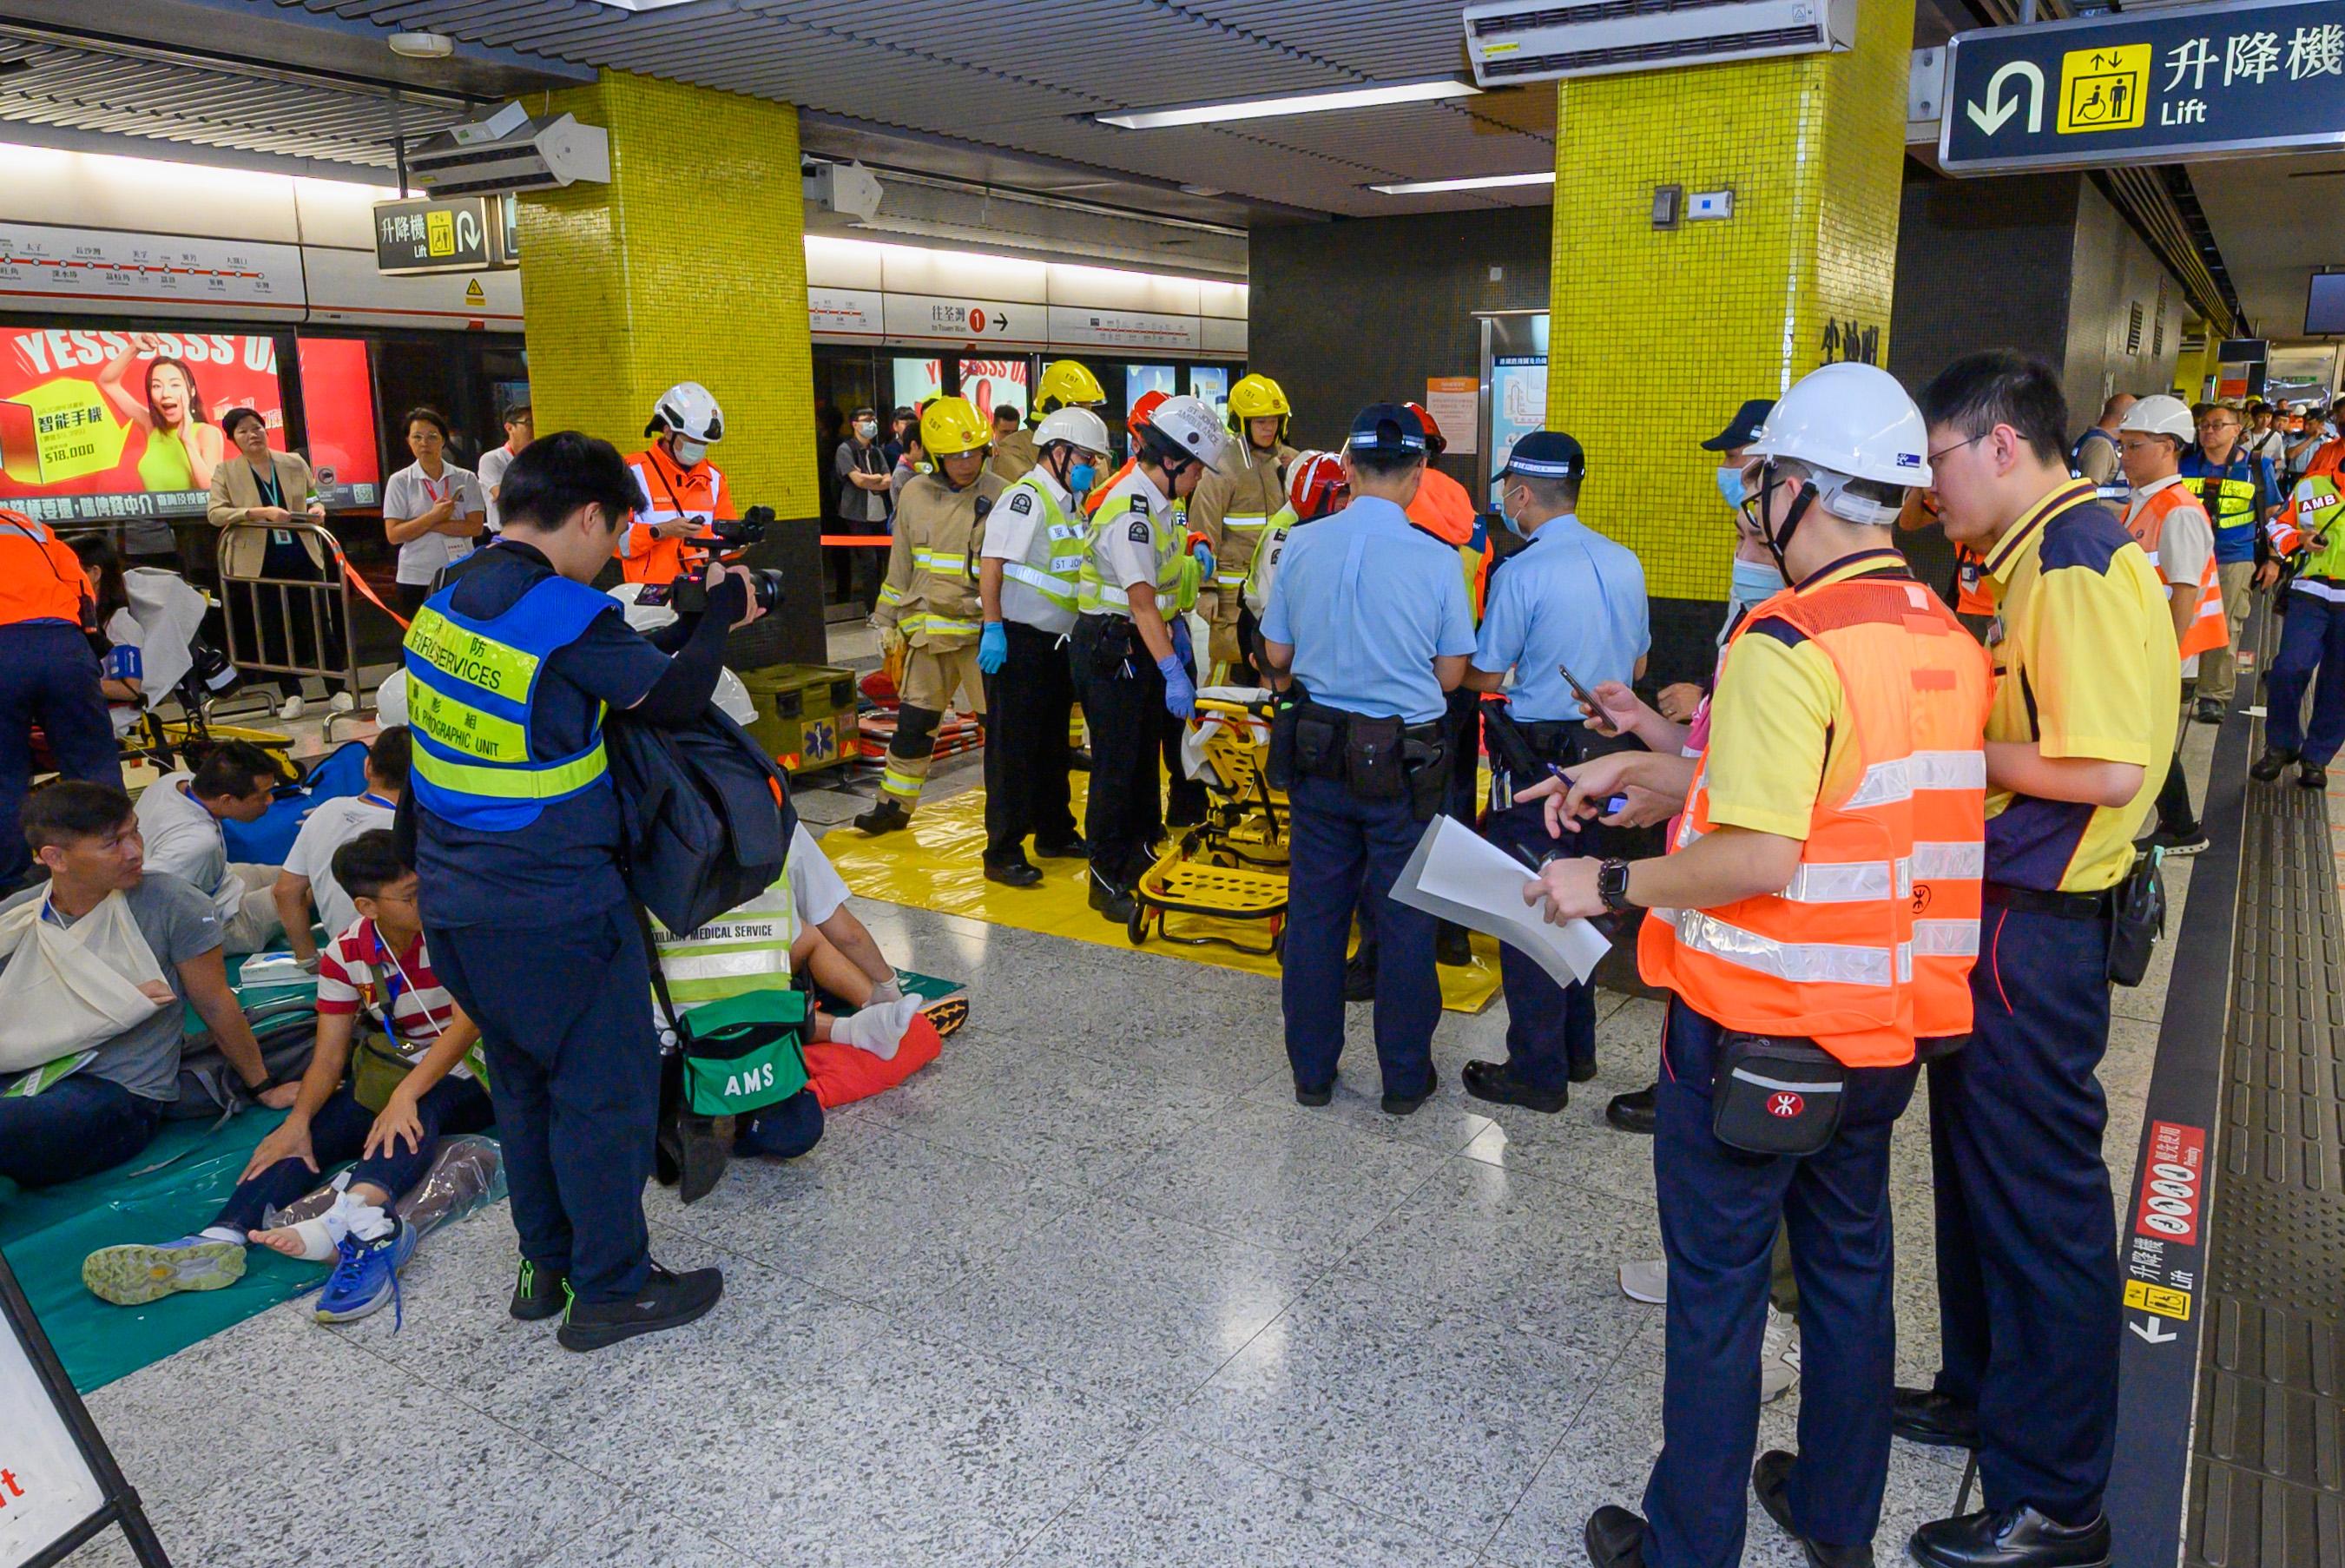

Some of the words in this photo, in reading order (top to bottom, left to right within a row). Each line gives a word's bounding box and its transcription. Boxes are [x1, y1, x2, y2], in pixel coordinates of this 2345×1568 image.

[2164, 23, 2345, 93] 升降機
[2160, 99, 2207, 127] Lift
[381, 214, 426, 243] 升降機
[413, 245, 428, 259] Lift
[932, 305, 965, 322] 往荃灣
[925, 359, 942, 385] Y
[38, 406, 102, 433] 智能手機
[1187, 405, 1198, 415] ST
[2302, 494, 2336, 512] AMB
[1056, 559, 1066, 570] ST
[432, 642, 502, 689] SERVICES
[475, 738, 500, 757] UNIT
[690, 926, 732, 941] MEDICAL
[734, 925, 773, 938] SERVICE
[724, 1062, 774, 1097] AMS
[2130, 1236, 2164, 1281] 升降機
[2170, 1269, 2194, 1290] Lift
